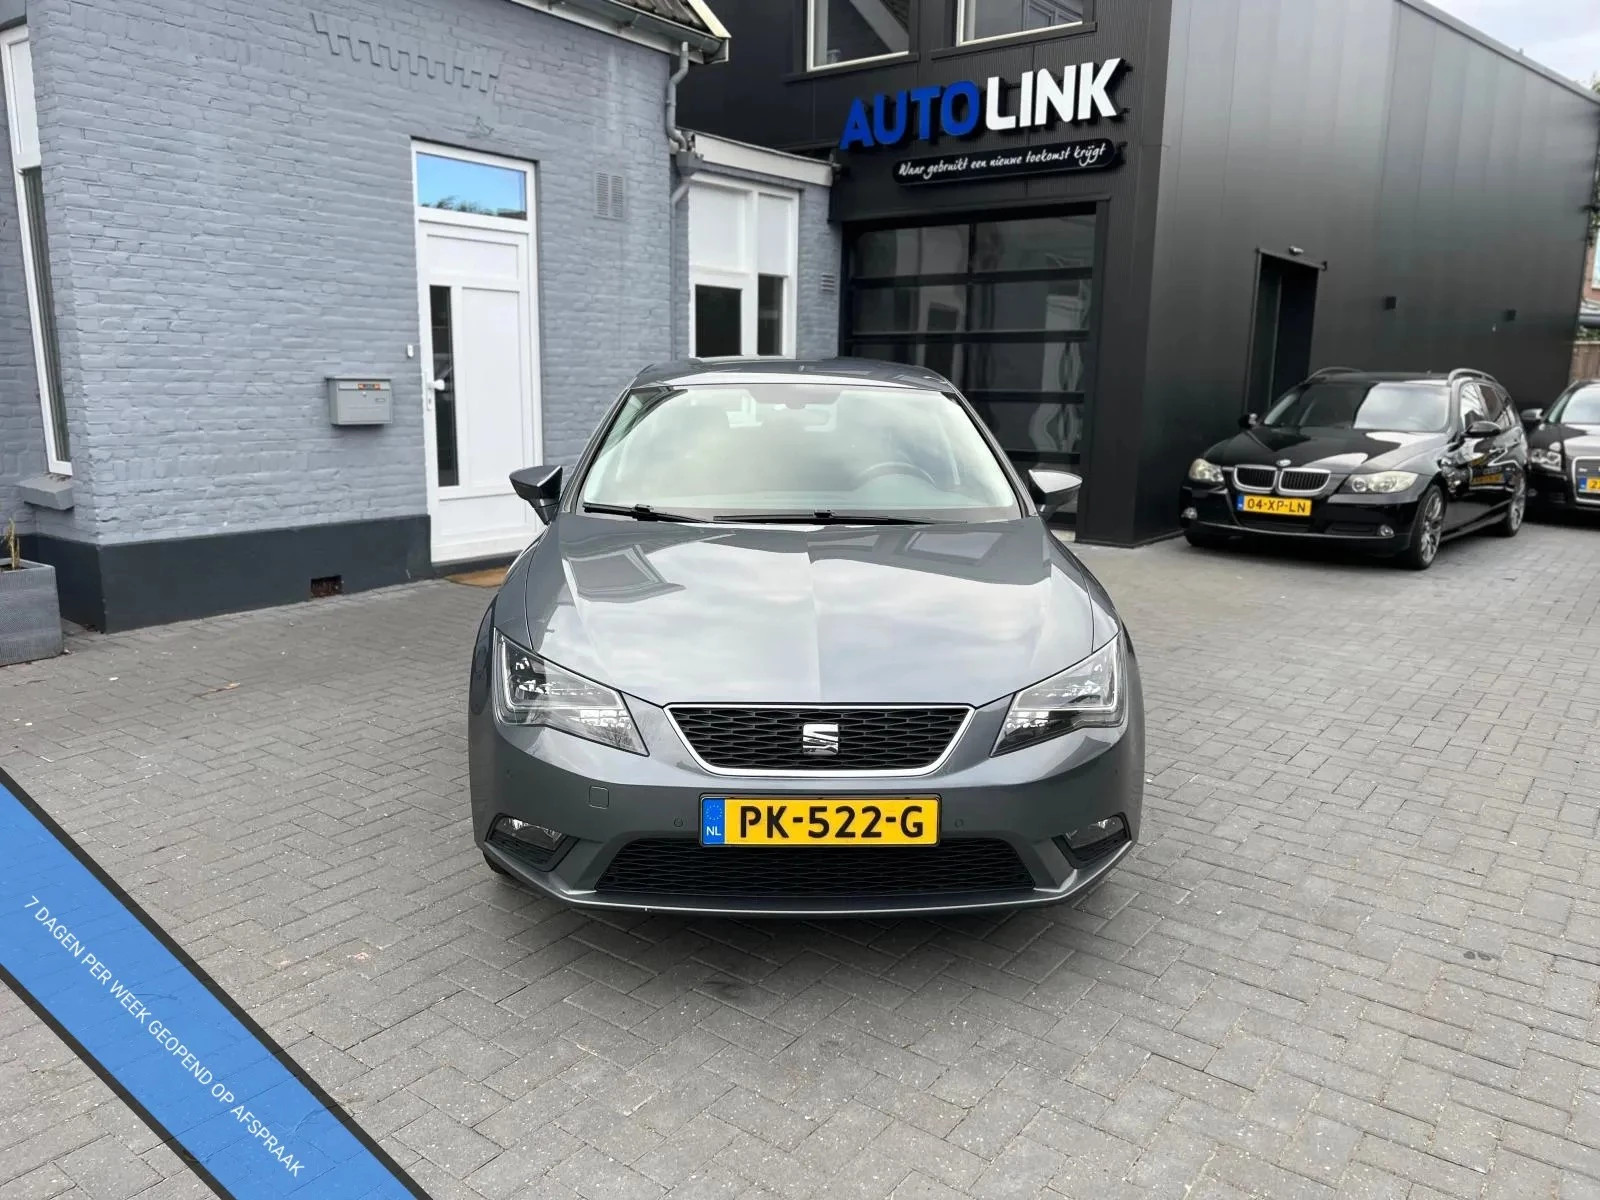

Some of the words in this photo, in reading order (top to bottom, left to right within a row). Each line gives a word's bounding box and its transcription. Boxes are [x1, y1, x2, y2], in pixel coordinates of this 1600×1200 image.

[840, 58, 1121, 150] AUTOLINK
[898, 162, 925, 176] Waar
[923, 157, 968, 180] gebruikt
[970, 160, 987, 169] een
[989, 156, 1022, 167] nieuwe
[1026, 146, 1071, 163] toekomst
[1074, 142, 1106, 167] krijgt
[1247, 498, 1306, 513] 04-XP-LN
[706, 826, 721, 836] NL
[739, 805, 924, 839] PK-522-G
